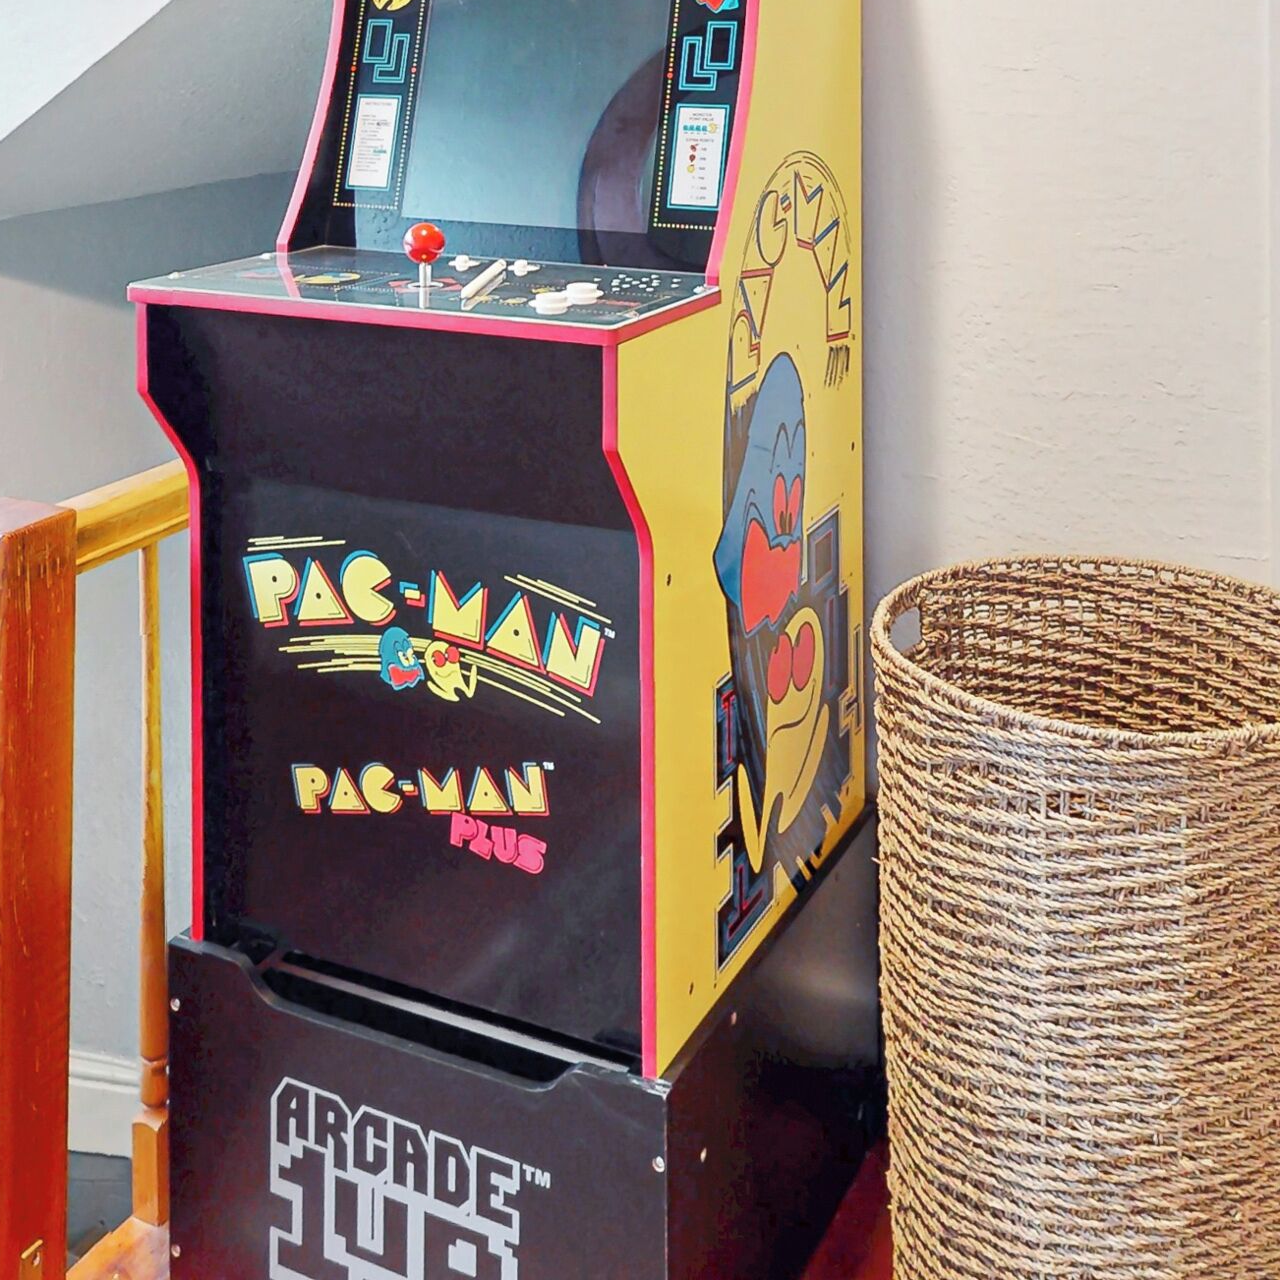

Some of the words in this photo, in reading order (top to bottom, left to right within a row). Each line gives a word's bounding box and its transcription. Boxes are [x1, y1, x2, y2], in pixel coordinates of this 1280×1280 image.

[242, 550, 605, 696] PAC-MAN
[291, 762, 550, 816] PAC-MAN
[450, 812, 547, 874] PLUS
[270, 1076, 520, 1232] ARCADE
